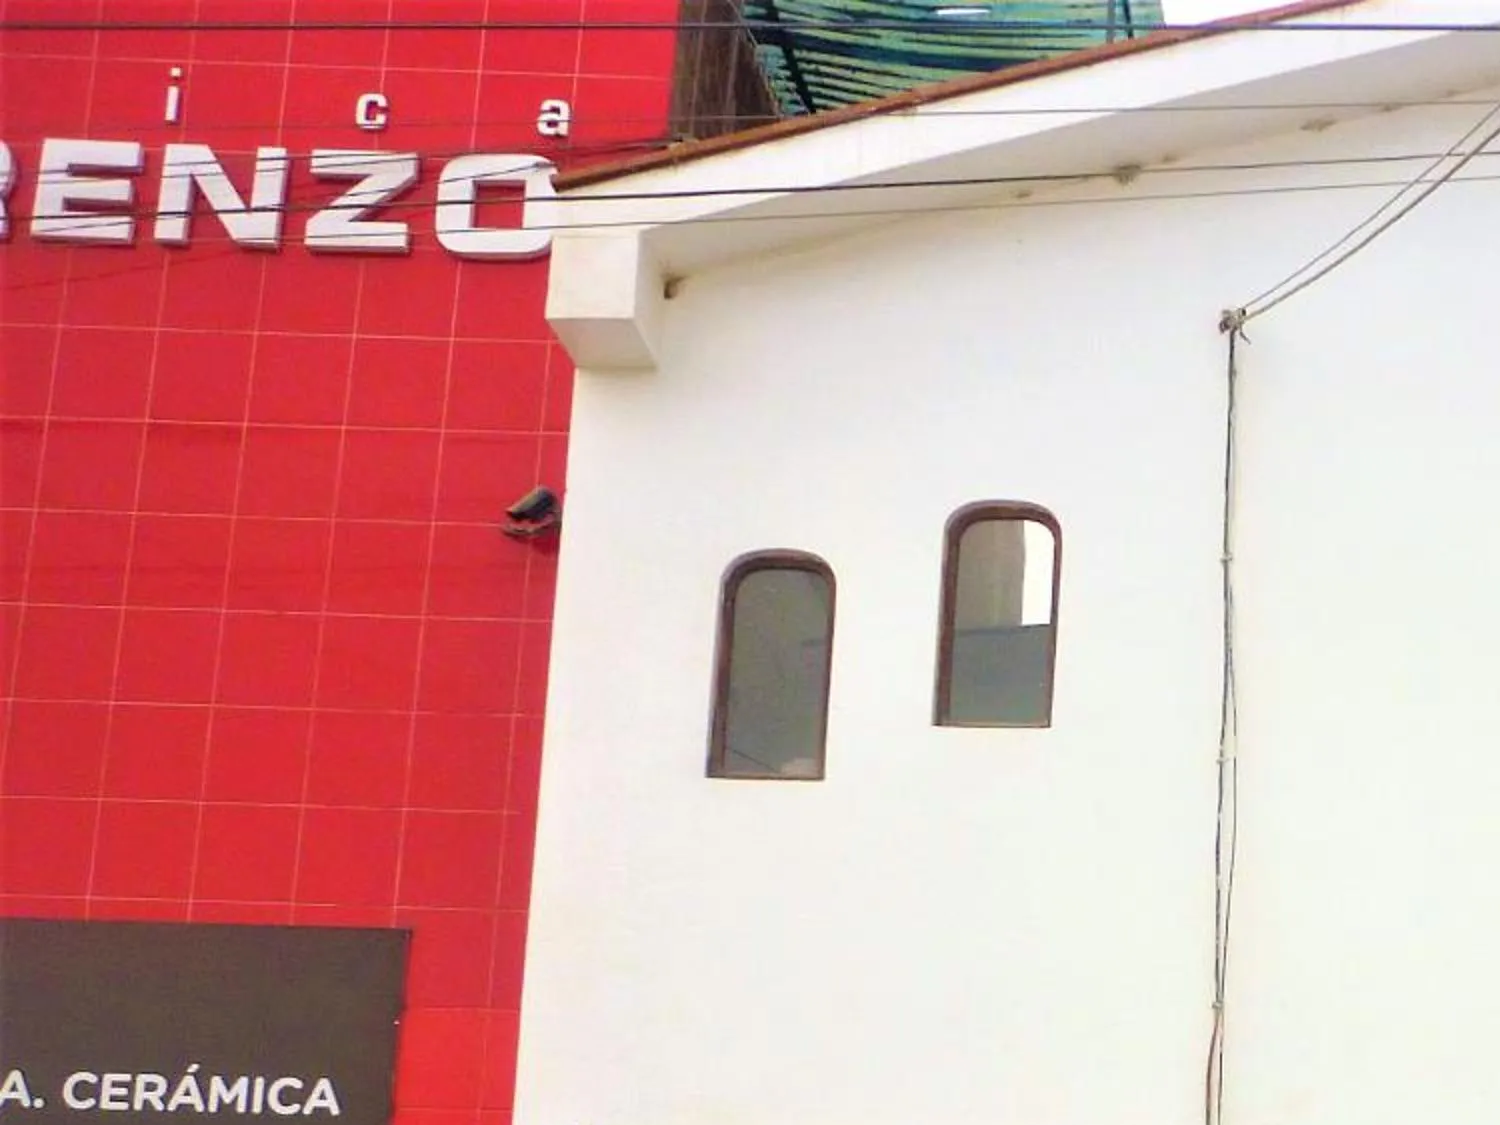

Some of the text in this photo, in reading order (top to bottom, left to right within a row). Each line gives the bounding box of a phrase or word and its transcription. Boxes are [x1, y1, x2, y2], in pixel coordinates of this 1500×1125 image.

[0, 137, 562, 262] ENZO
[0, 1063, 341, 1116] A. CERÁMICA
